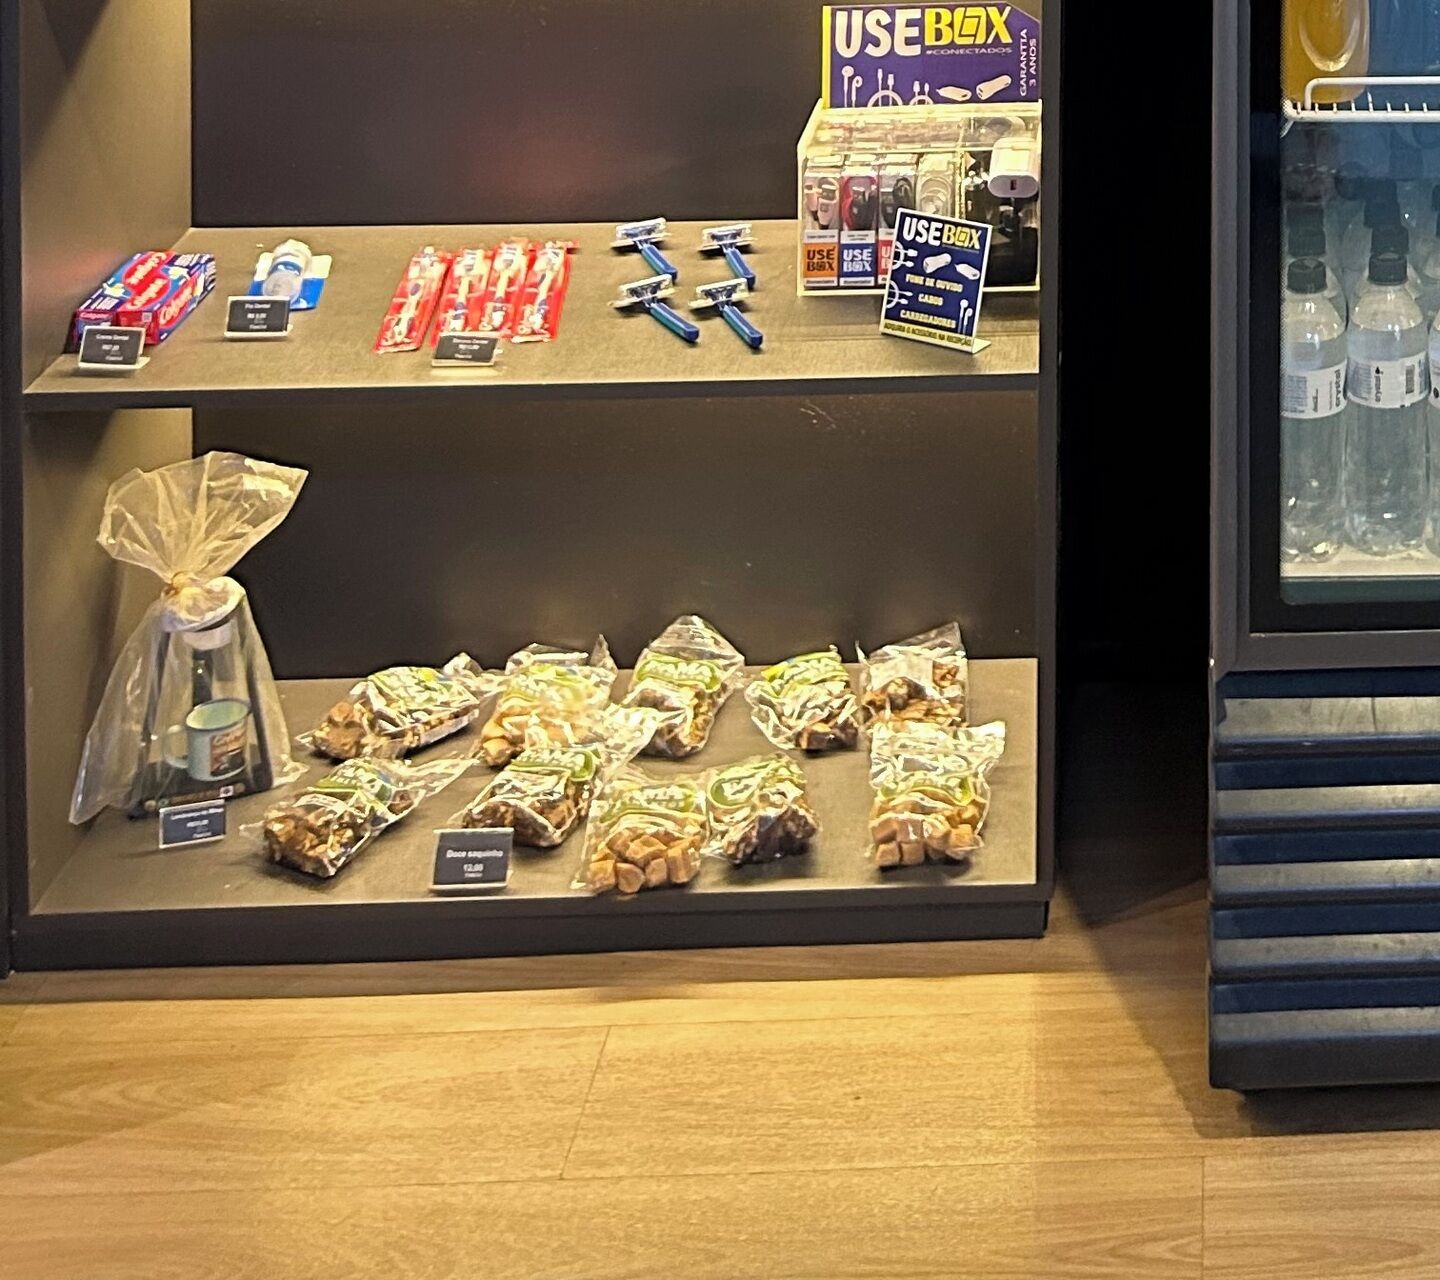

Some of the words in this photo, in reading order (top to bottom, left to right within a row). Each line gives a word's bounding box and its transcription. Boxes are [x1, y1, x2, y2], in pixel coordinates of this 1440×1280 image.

[925, 46, 1014, 56] #CONECTADOS
[1028, 38, 1037, 75] ANOS
[1018, 28, 1029, 97] GARANTIA
[1028, 77, 1037, 87] 3
[807, 248, 836, 261] USE
[843, 248, 873, 261] USE
[806, 260, 835, 272] BOX
[843, 261, 872, 272] BOX
[158, 286, 193, 326] Colgate
[918, 293, 944, 307] CABOS
